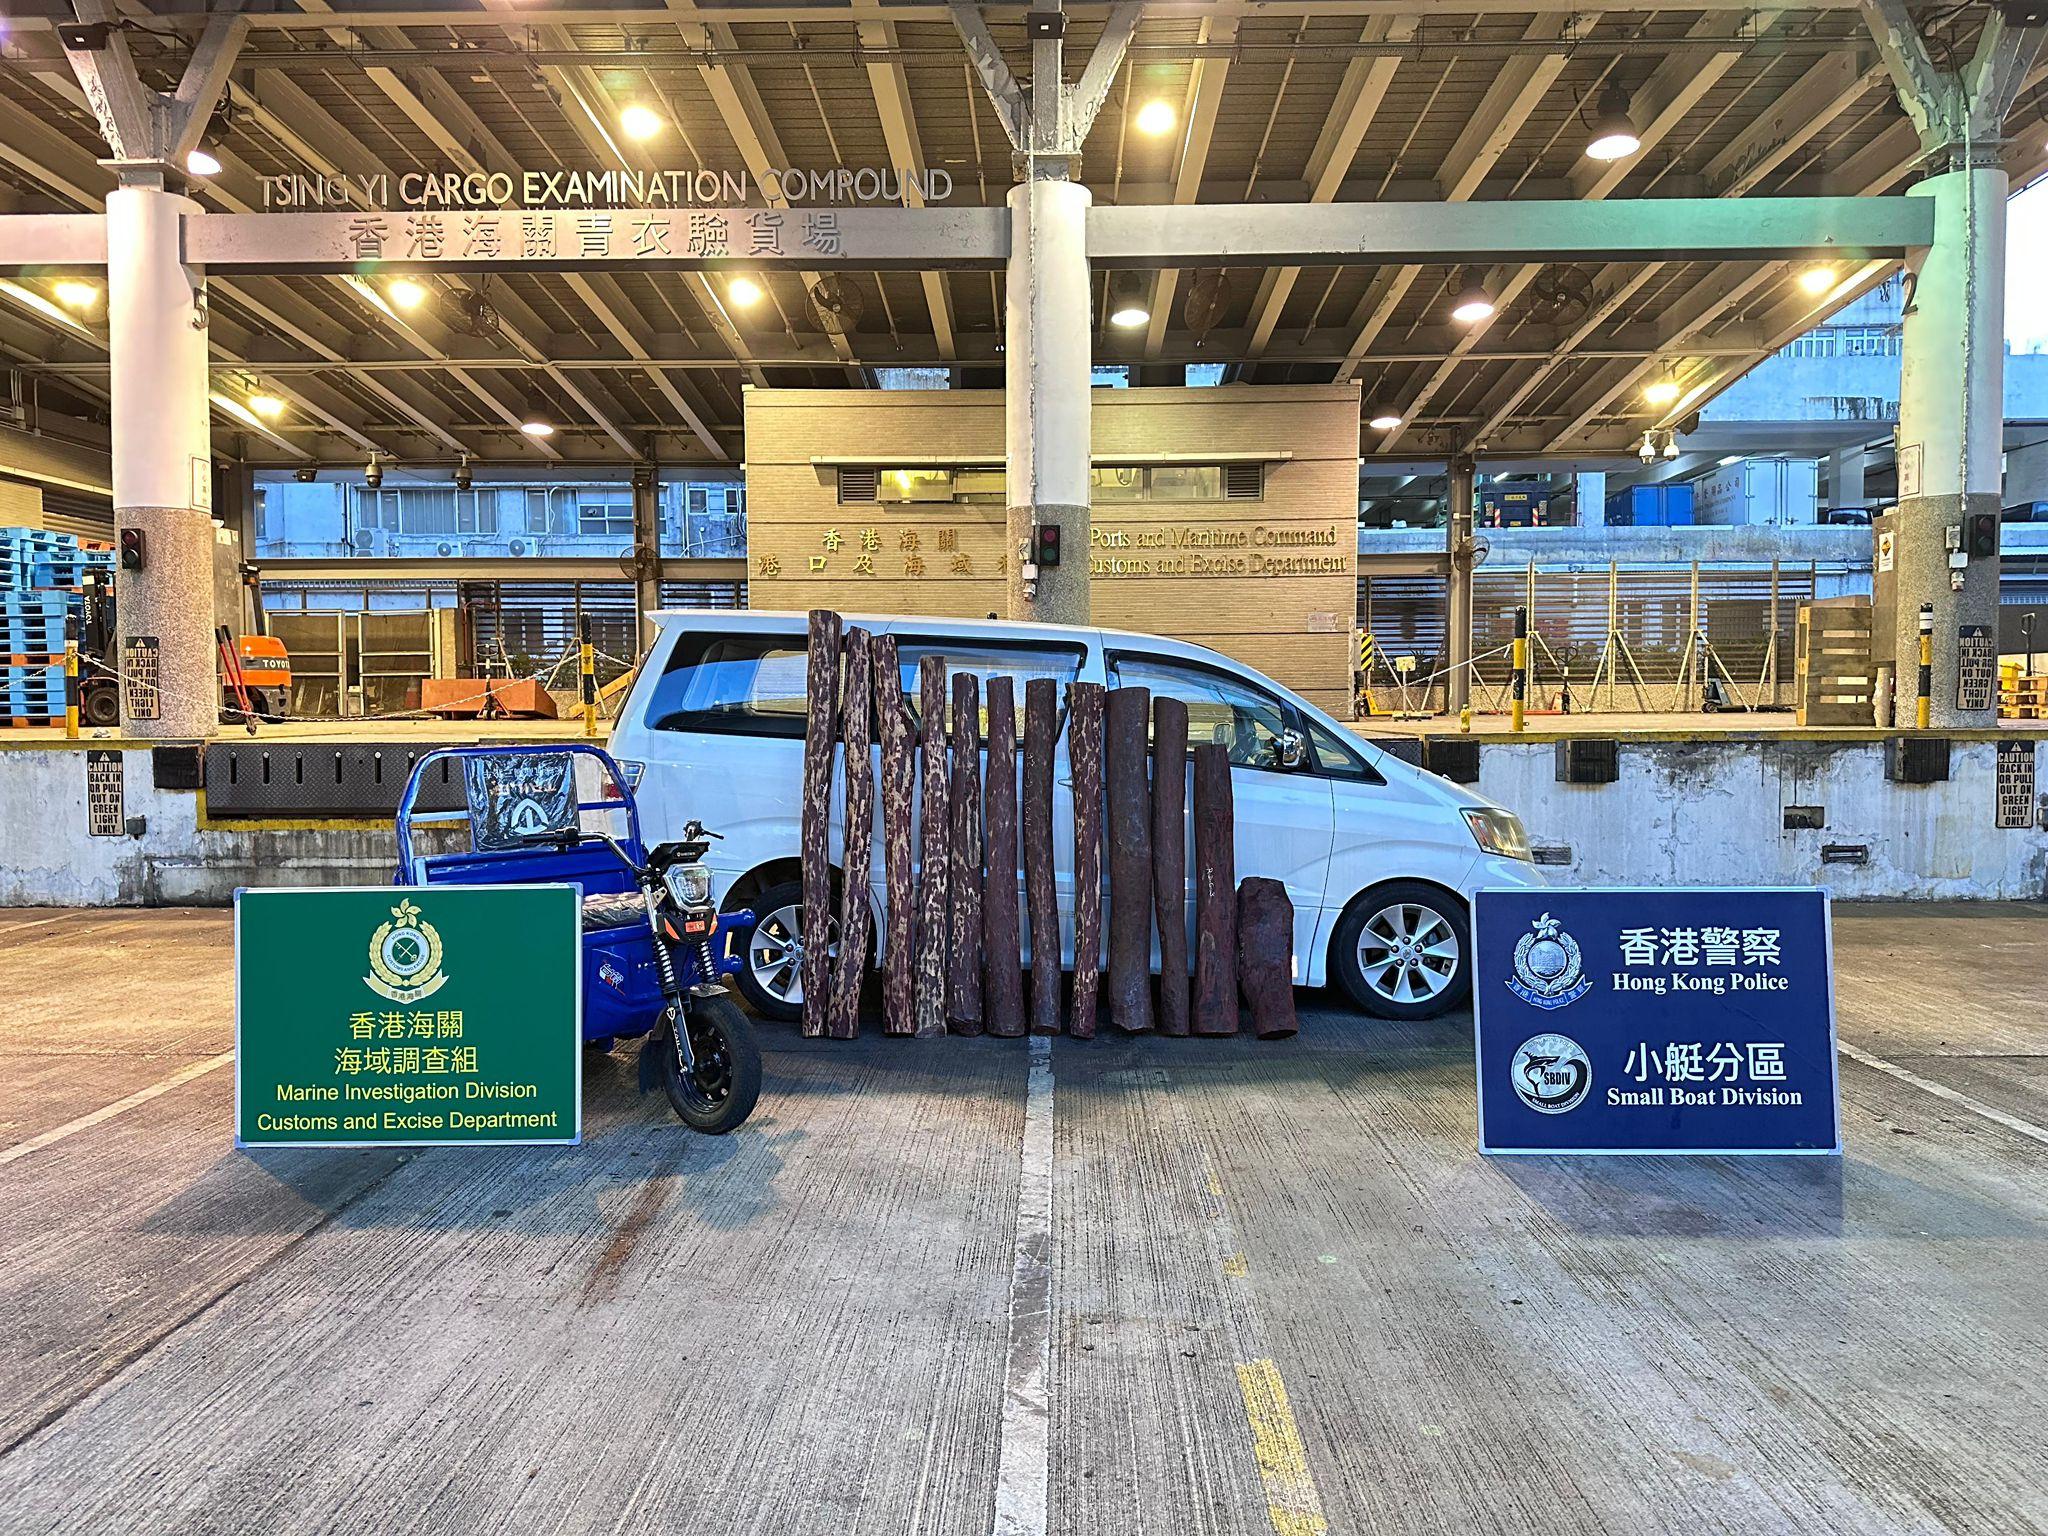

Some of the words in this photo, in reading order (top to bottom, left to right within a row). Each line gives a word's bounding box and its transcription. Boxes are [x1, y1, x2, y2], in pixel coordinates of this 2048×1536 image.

[256, 173, 348, 206] TSING
[357, 173, 388, 206] YI
[399, 171, 514, 205] CARGO
[523, 169, 746, 204] EXAMINATION
[759, 167, 953, 200] COMPOUND
[349, 212, 843, 259] 香港海關青衣驗貨場
[1901, 272, 1918, 316] 2
[822, 527, 957, 552] 香港海關
[1090, 528, 1130, 548] Ports
[1137, 527, 1165, 547] and
[1171, 527, 1248, 548] Maritime
[1253, 525, 1337, 547] Command
[1156, 554, 1184, 574] and
[1190, 554, 1247, 574] Excise
[1250, 553, 1347, 578] Department
[84, 595, 93, 625] TOYOTA
[1997, 752, 2034, 762] CAUTION
[87, 762, 122, 772] CAUTION
[1999, 764, 2022, 773] BACK
[2024, 764, 2032, 773] IN
[89, 773, 110, 782] BACK
[113, 773, 121, 782] IN
[1999, 774, 2011, 783] OR
[2014, 774, 2032, 783] PULL
[89, 784, 100, 793] OR
[103, 784, 121, 792] PULL
[2000, 785, 2017, 794] OUT
[2020, 785, 2031, 794] ON
[91, 794, 106, 803] OUT
[109, 794, 120, 803] ON
[2002, 795, 2029, 805] GREEN
[93, 804, 118, 813] GREEN
[2003, 806, 2028, 815] LIGHT
[94, 814, 118, 824] LIGHT
[2005, 817, 2025, 825] ONLY
[97, 825, 116, 833] ONLY
[391, 932, 405, 940] HONG
[406, 932, 420, 940] KONG
[1619, 927, 1782, 967] 香港警察
[1612, 973, 1667, 994] Hong
[1671, 973, 1726, 995] Kong
[1730, 973, 1789, 991] Police
[349, 1010, 464, 1040] 香港海關
[333, 1045, 479, 1076] 海域調查組
[1624, 1042, 1787, 1083] 小艇分區
[1544, 1071, 1571, 1085] SBDIV
[277, 1084, 339, 1101] Marine
[345, 1082, 459, 1104] Investigation
[465, 1081, 537, 1099] Division
[1607, 1087, 1663, 1106] Small
[1669, 1087, 1716, 1106] Boat
[1721, 1087, 1803, 1106] Division
[257, 1113, 338, 1130] Customs
[343, 1112, 377, 1130] and
[383, 1112, 443, 1129] Excise
[449, 1110, 558, 1132] Department
